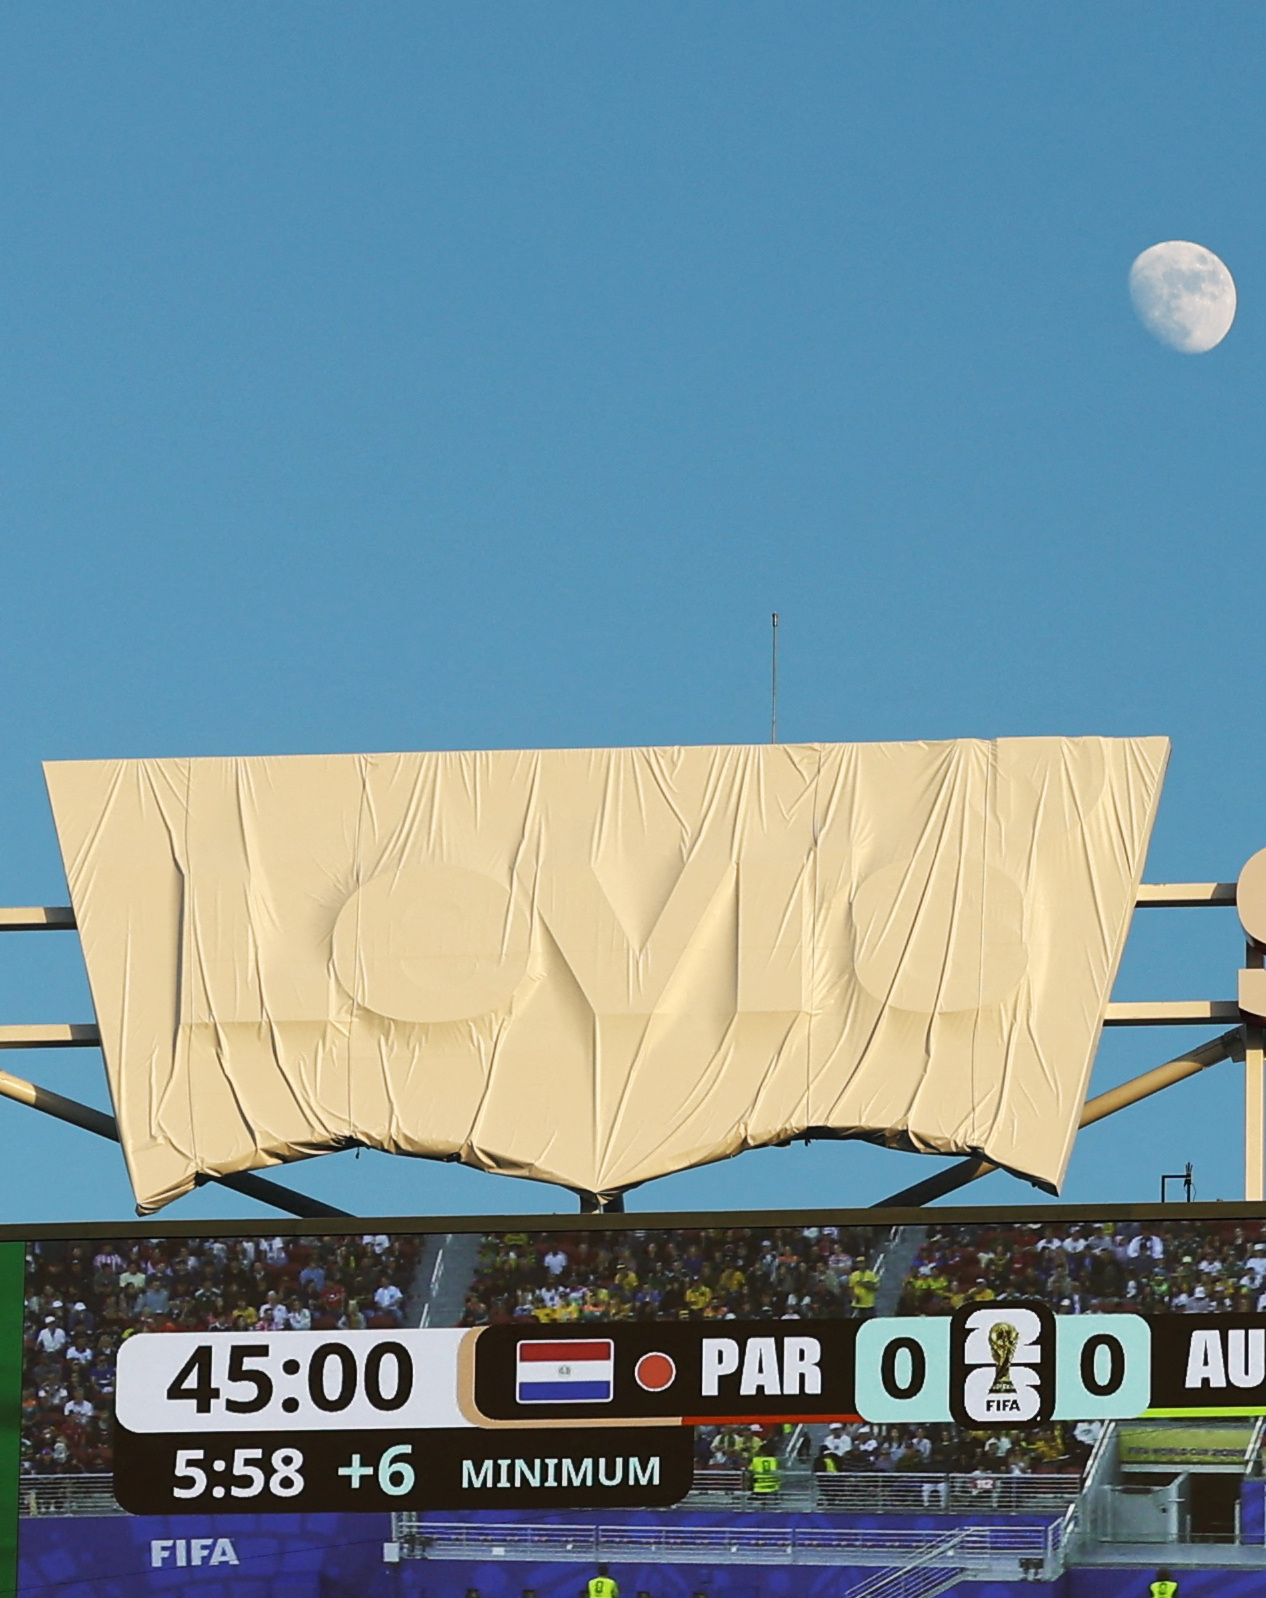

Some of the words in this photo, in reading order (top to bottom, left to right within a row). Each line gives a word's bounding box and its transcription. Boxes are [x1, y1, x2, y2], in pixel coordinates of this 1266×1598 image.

[166, 1341, 414, 1415] 45:00
[701, 1336, 822, 1397] PAR
[880, 1336, 926, 1400] 0
[1079, 1333, 1125, 1397] 0
[986, 1399, 1021, 1412] FIFA
[173, 1447, 305, 1499] 5:58
[337, 1444, 415, 1496] +6
[461, 1456, 660, 1489] MINIMUM
[151, 1537, 240, 1568] FIFA
